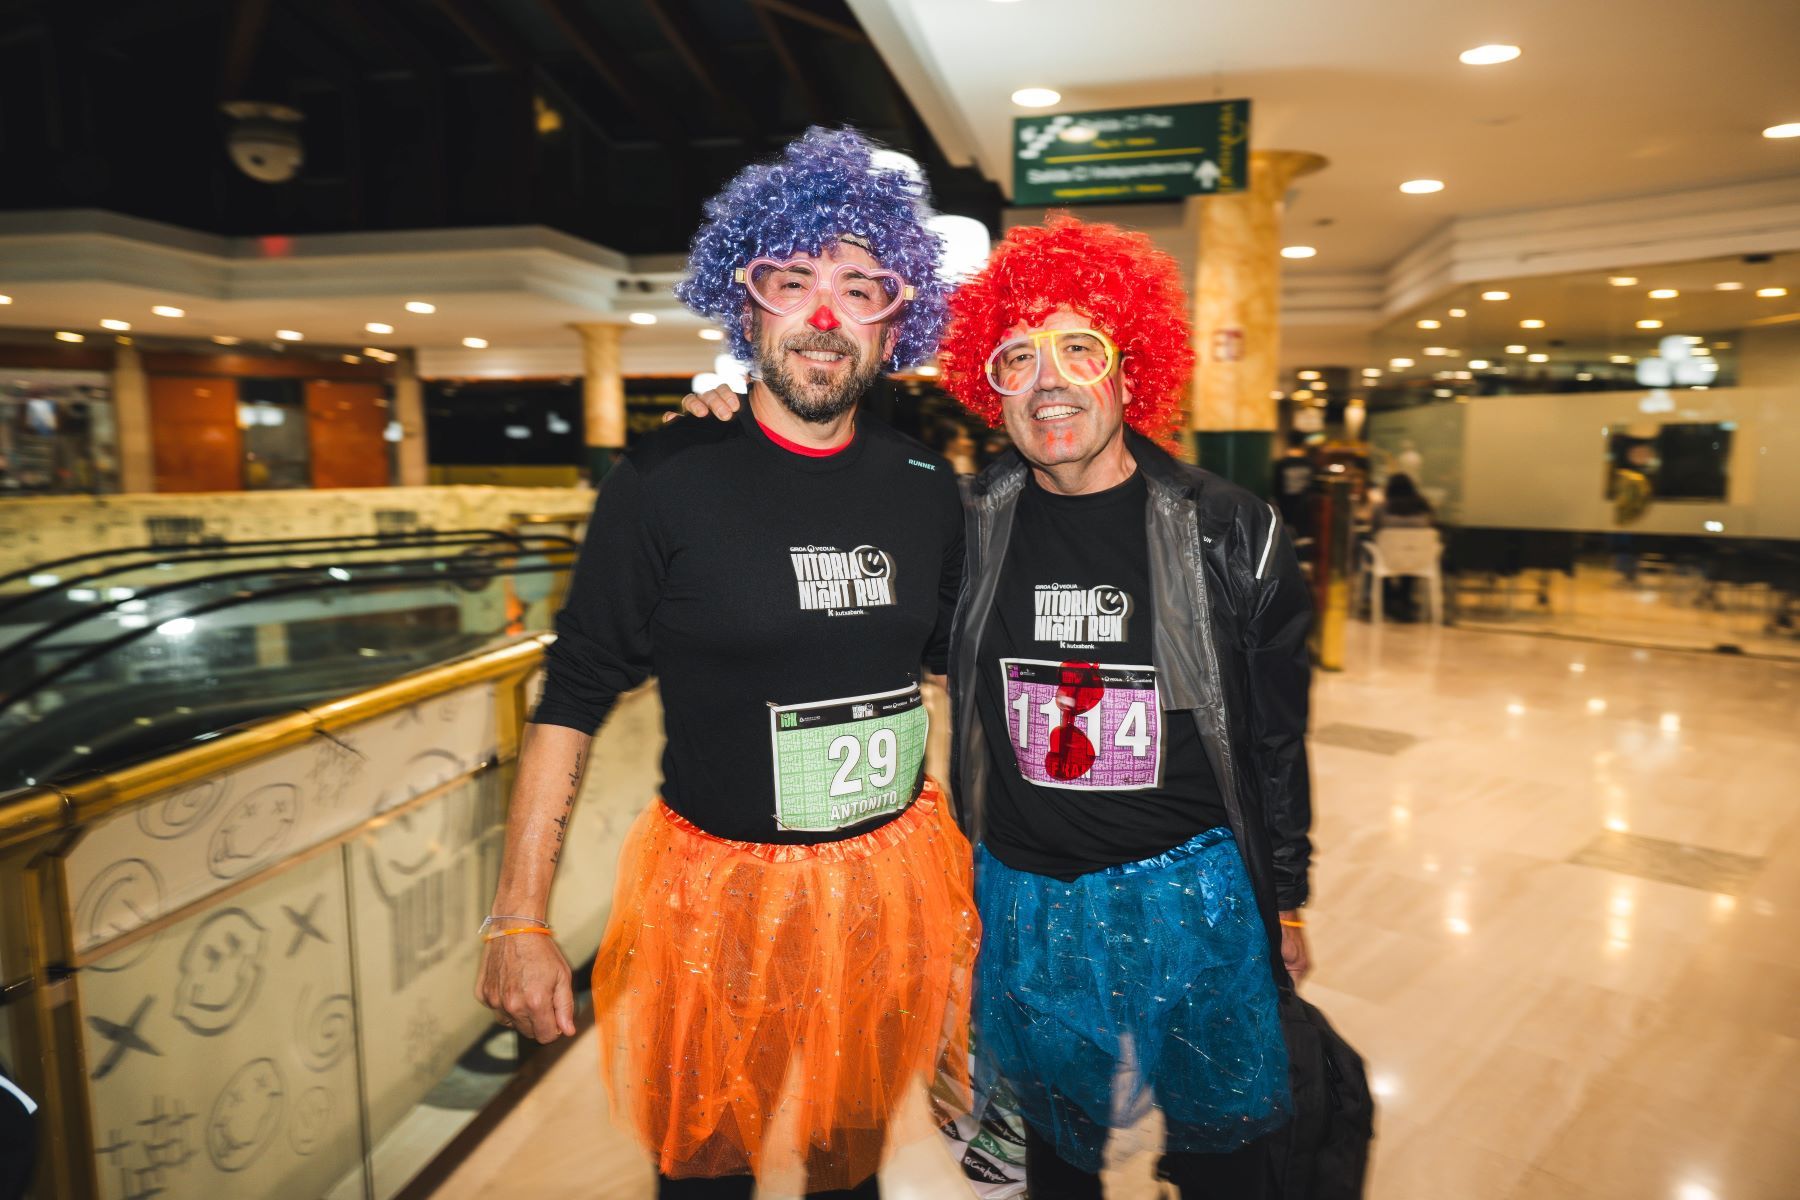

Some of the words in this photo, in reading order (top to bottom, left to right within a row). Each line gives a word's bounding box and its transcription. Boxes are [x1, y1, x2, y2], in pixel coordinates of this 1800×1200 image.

[790, 552, 862, 581] VITORIA
[797, 579, 850, 610] NIGHT
[853, 577, 891, 607] RUN
[1034, 589, 1098, 616] VITORIA
[1034, 615, 1085, 641] NIGHT
[1087, 615, 1122, 642] RUN
[1012, 692, 1151, 757] 1114
[827, 727, 898, 798] 29
[829, 790, 898, 821] ANTONITO
